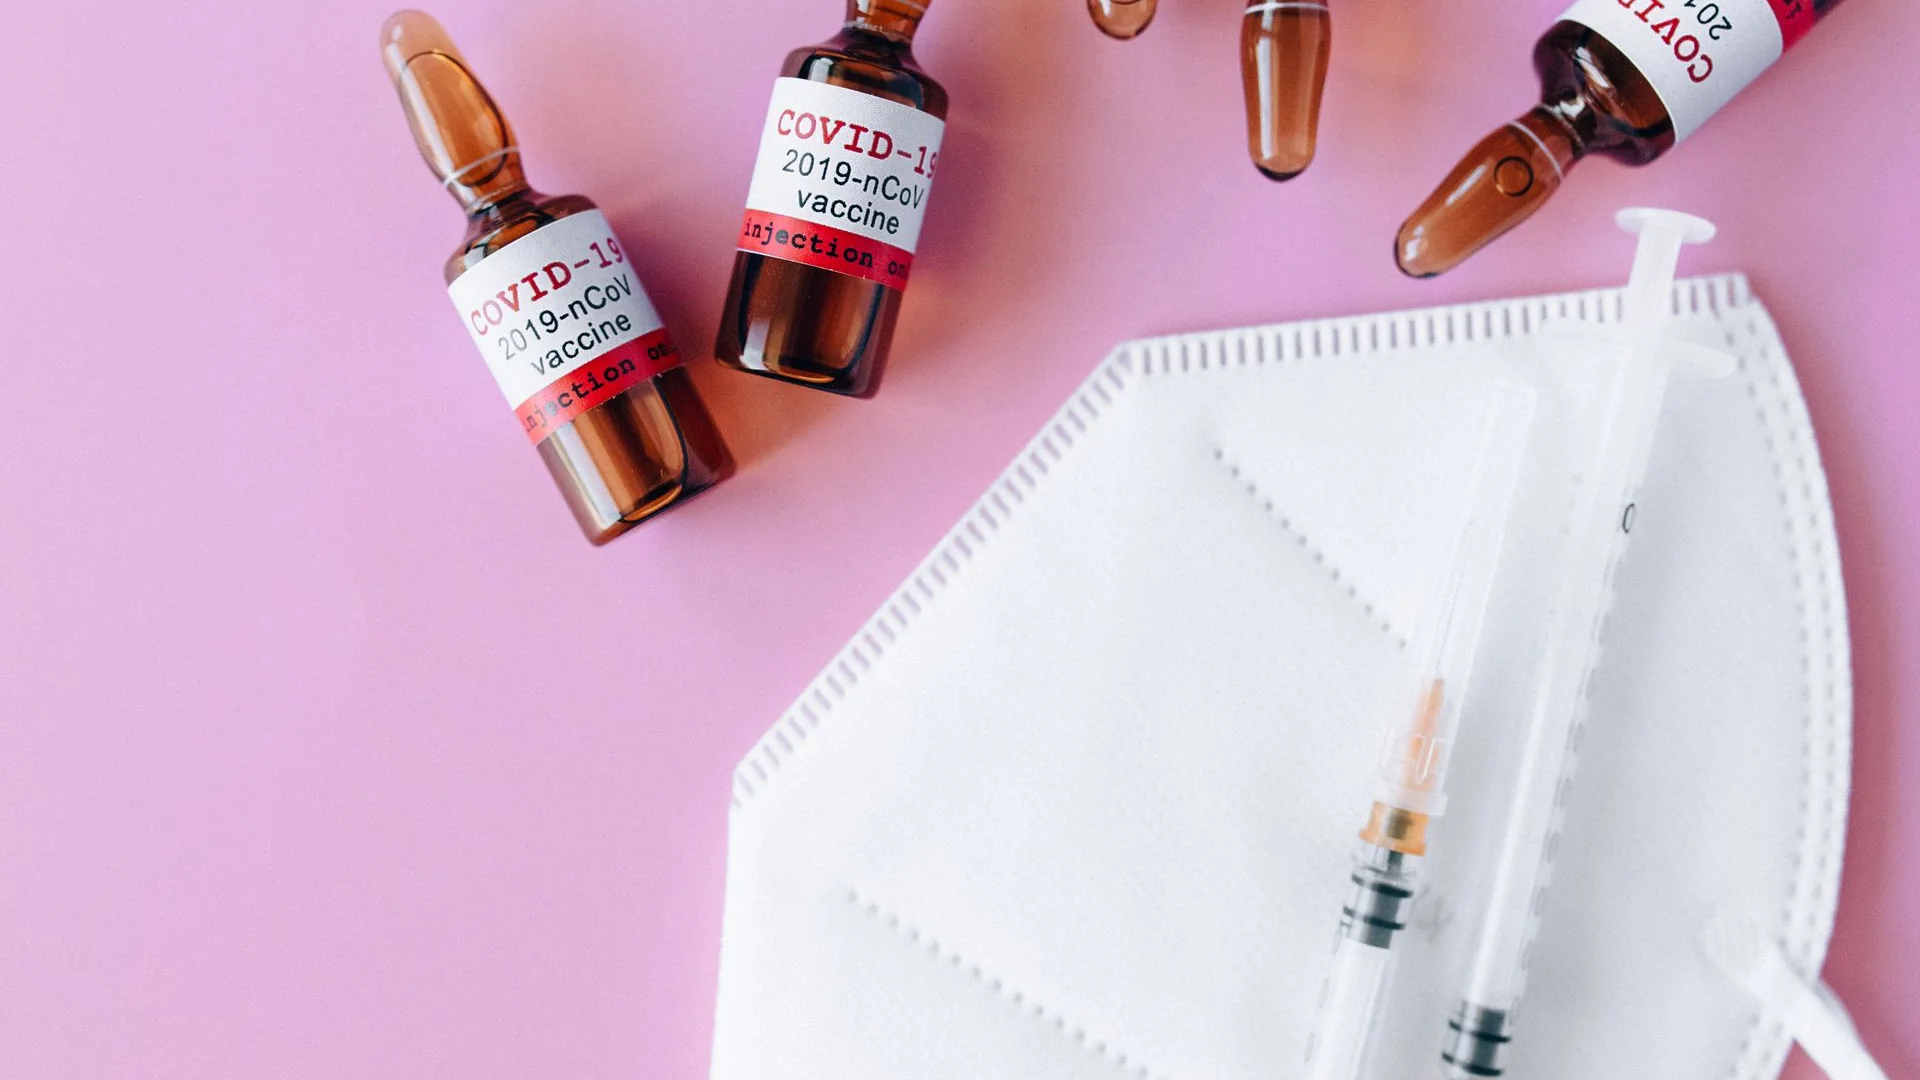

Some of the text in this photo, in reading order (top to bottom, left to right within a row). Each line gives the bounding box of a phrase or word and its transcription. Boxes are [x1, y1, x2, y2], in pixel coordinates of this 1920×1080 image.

[777, 109, 938, 179] COVID-19
[782, 149, 925, 209] 2019-nCoV
[743, 217, 873, 268] injection
[797, 189, 900, 234] vaccine
[470, 236, 624, 336] COVID-19
[497, 273, 632, 360] 2019-nCoV
[530, 313, 632, 375] vaccine
